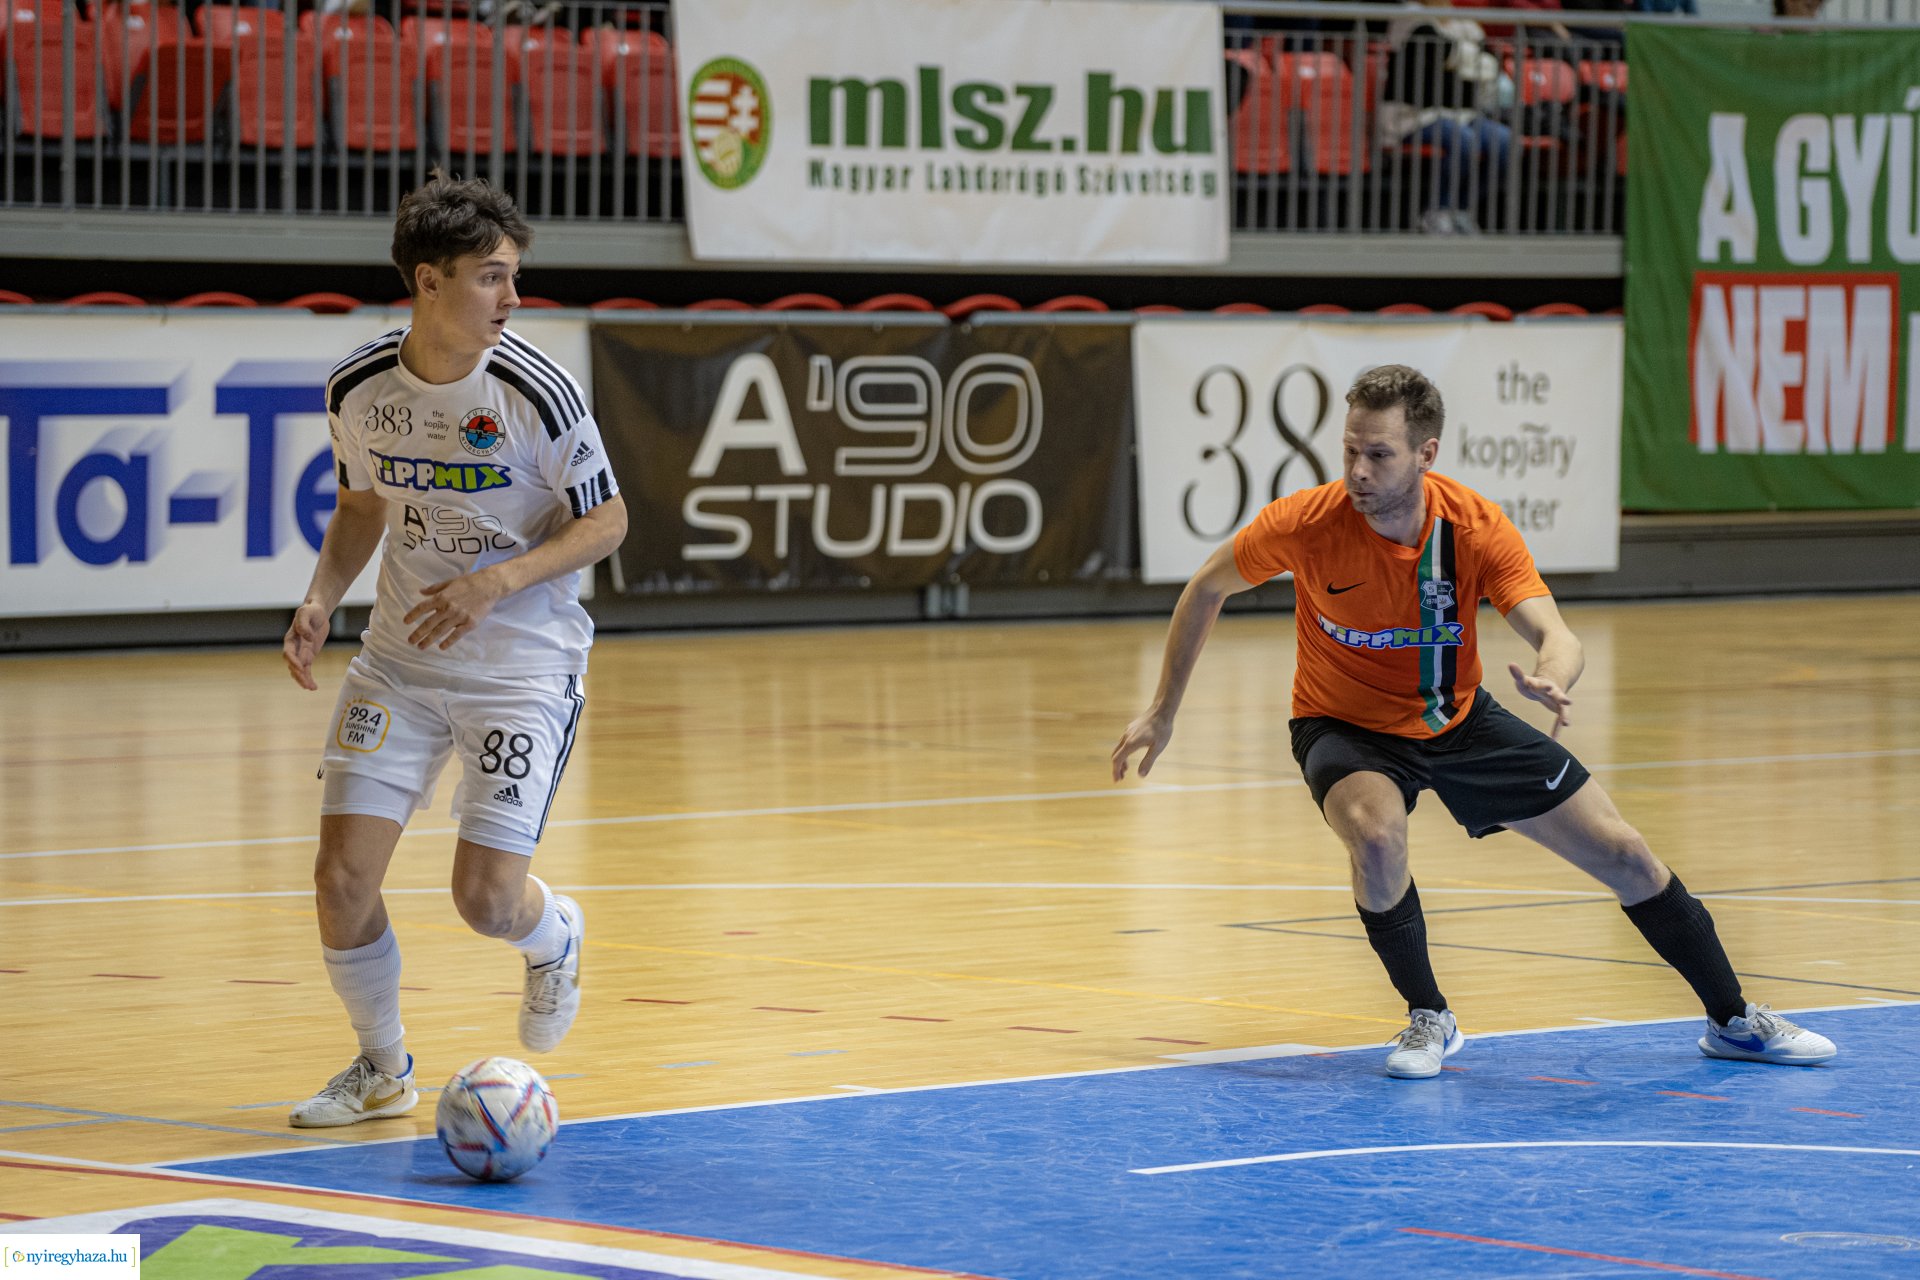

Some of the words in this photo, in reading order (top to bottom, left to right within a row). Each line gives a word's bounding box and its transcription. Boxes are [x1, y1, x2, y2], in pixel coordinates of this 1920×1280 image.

[808, 65, 1215, 153] mlsz.hu
[807, 158, 912, 193] Magyar
[1697, 112, 1759, 263] A
[1496, 361, 1551, 404] the
[1694, 284, 1893, 456] NEM
[365, 404, 413, 437] 383
[432, 410, 445, 419] the
[466, 409, 501, 425] FUTSAL
[688, 352, 1043, 477] A'90
[427, 432, 447, 441] water
[1182, 364, 1376, 541] 38
[570, 448, 595, 467] adidas
[681, 479, 1043, 561] STUDIO
[1502, 492, 1561, 533] ater
[344, 721, 377, 735] SUNSHINE
[348, 706, 382, 727] 99.4
[347, 730, 365, 744] FM
[479, 729, 534, 780] 88
[493, 793, 524, 808] adidas
